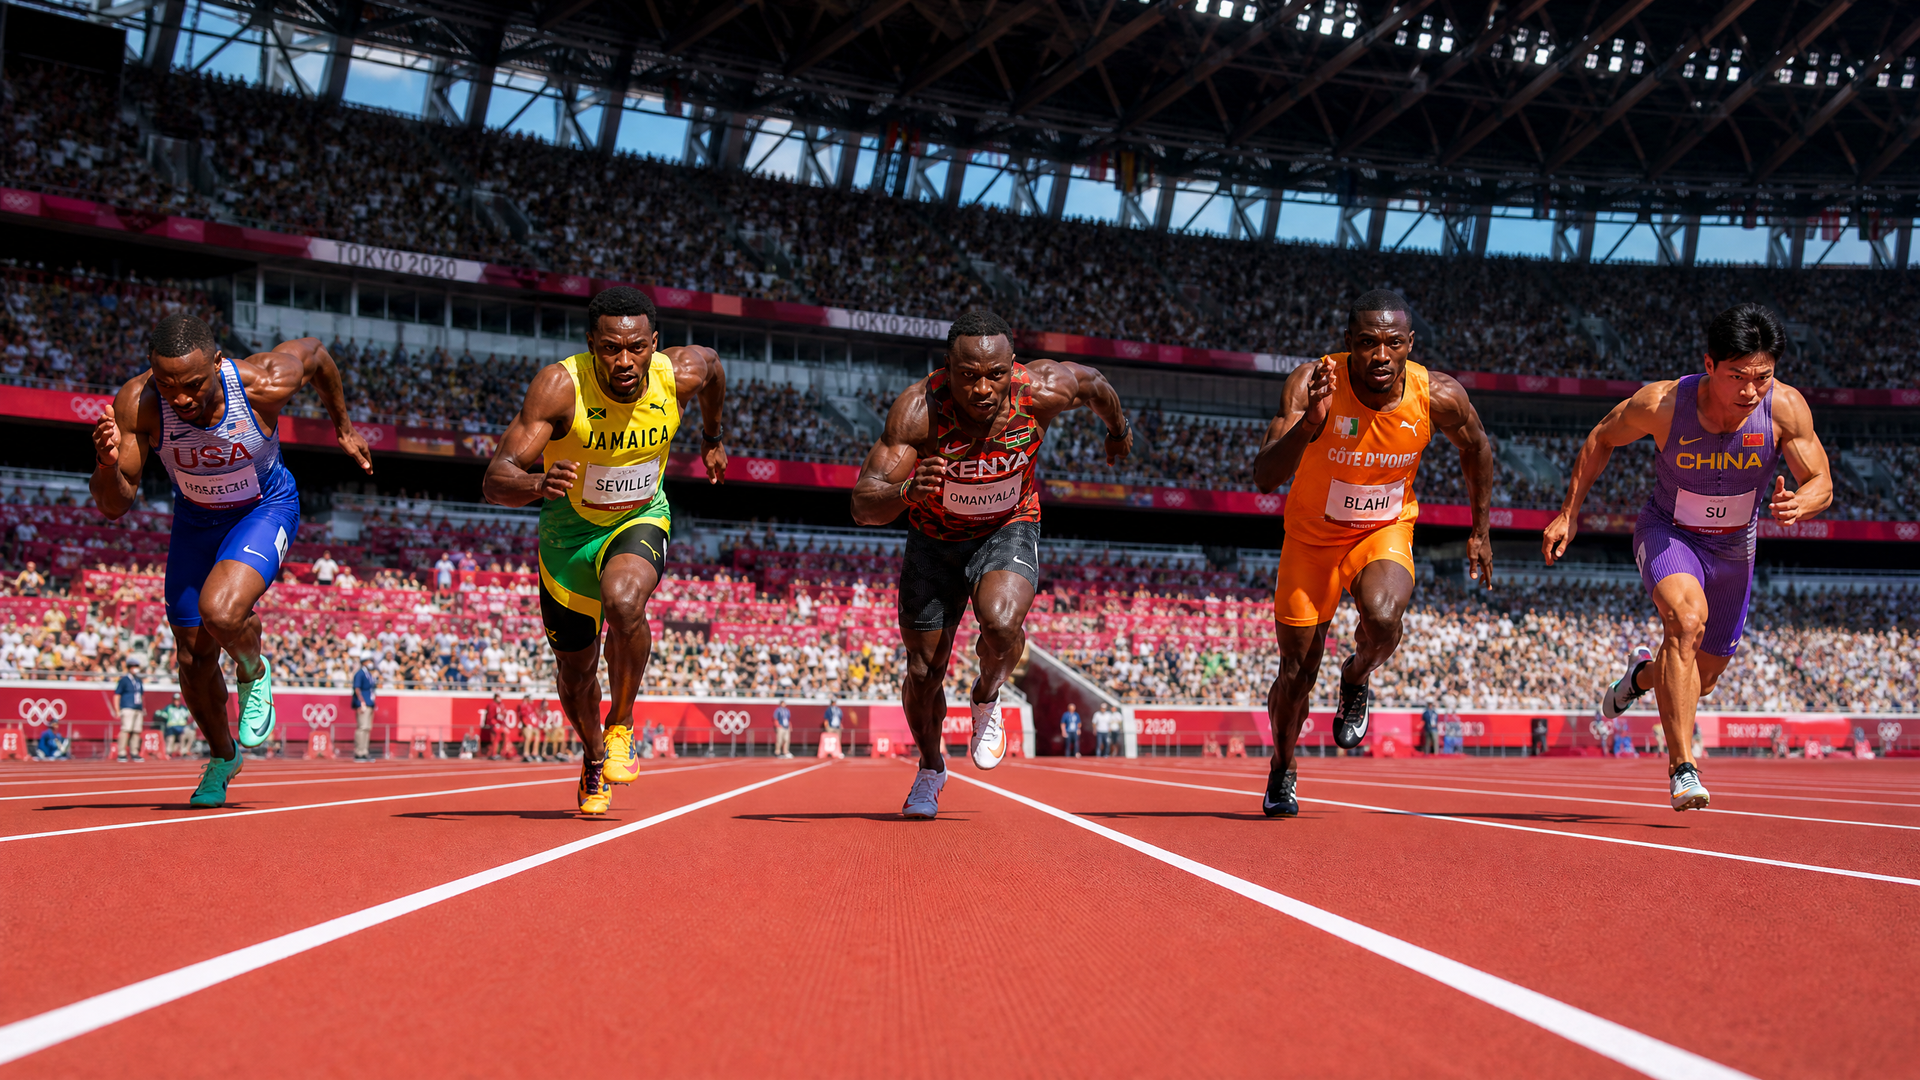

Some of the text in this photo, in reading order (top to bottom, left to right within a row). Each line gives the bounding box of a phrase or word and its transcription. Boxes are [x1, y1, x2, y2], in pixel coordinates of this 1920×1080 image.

[334, 242, 457, 279] TOKYO 2020
[848, 310, 941, 339] TOKYO 2020
[582, 424, 669, 450] JAMAICA
[174, 442, 253, 469] USA
[943, 450, 1029, 478] KENYA
[1328, 446, 1418, 468] CÔTE D'VOIRE
[1676, 452, 1762, 470] CHINA
[595, 473, 651, 492] SEVILLE
[949, 486, 1015, 505] OMANYALA
[1343, 495, 1390, 511] BLAHI
[1705, 506, 1727, 518] SU
